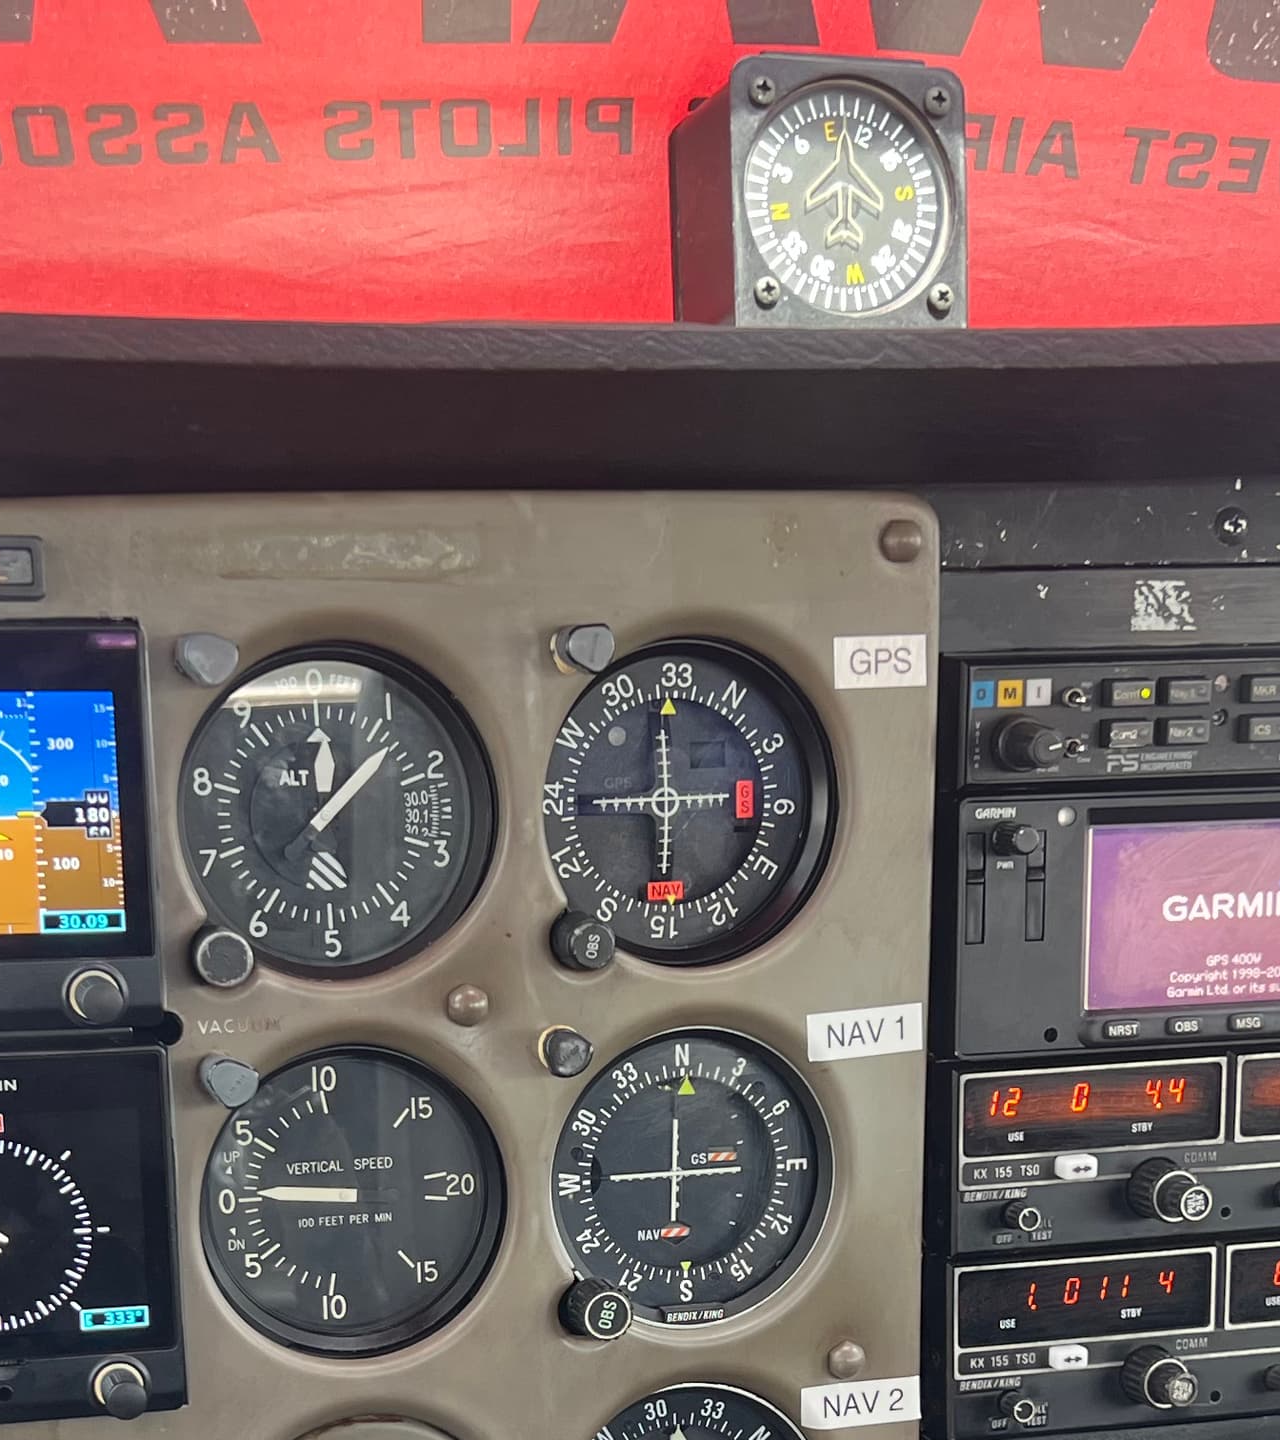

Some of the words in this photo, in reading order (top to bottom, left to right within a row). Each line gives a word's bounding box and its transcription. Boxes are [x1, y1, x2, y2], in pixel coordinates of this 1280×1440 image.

[849, 648, 912, 676] GPS
[47, 738, 74, 750] 300
[58, 914, 108, 929] 30.09
[1206, 954, 1230, 967] GPS
[1232, 953, 1262, 966] 400W
[1169, 969, 1228, 983] Copyright
[1167, 985, 1203, 998] Garmin
[1233, 984, 1246, 996] or
[1249, 982, 1265, 994] its
[1109, 1023, 1138, 1037] NRST
[1174, 1020, 1198, 1034] OBS
[1236, 1016, 1262, 1030] MSG
[827, 1018, 886, 1048] NAV
[894, 1016, 905, 1039] 1
[286, 1160, 344, 1175] VERTICAL
[354, 1156, 393, 1170] SPEED
[973, 1168, 988, 1180] KX
[994, 1166, 1013, 1179] 155
[1020, 1164, 1040, 1177] TSO
[298, 1218, 315, 1228] 100
[319, 1215, 344, 1226] FEET
[349, 1213, 369, 1225] PER
[375, 1213, 392, 1223] MIN
[822, 1393, 880, 1418] NAV
[889, 1389, 904, 1411] 2
